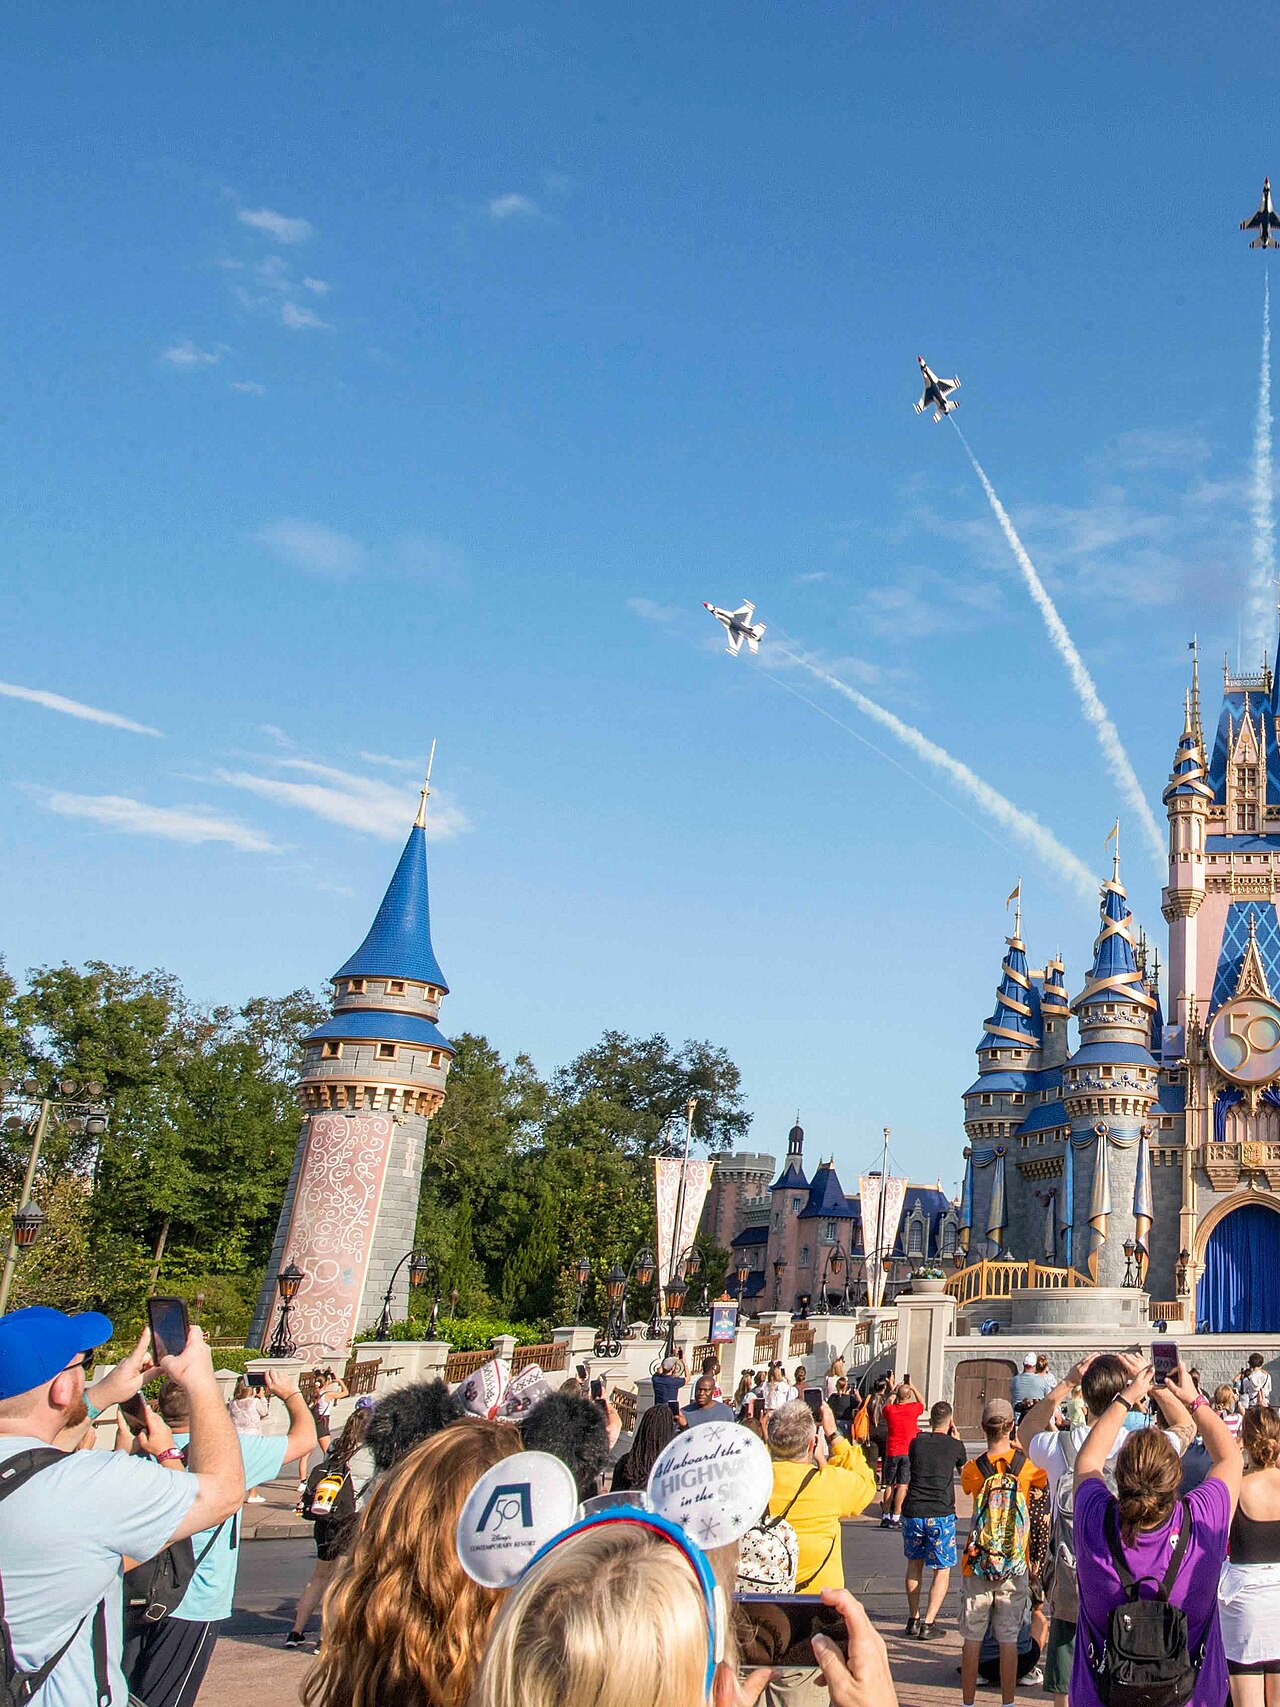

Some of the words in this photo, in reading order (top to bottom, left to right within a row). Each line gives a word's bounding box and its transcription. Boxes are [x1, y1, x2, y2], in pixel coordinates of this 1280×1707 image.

[299, 1256, 340, 1295] 50
[654, 1458, 675, 1479] All
[673, 1443, 722, 1471] aboard
[721, 1442, 741, 1457] the
[680, 1497, 692, 1507] in
[694, 1486, 714, 1503] the
[493, 1499, 520, 1531] 50
[514, 1540, 536, 1548] RESORT
